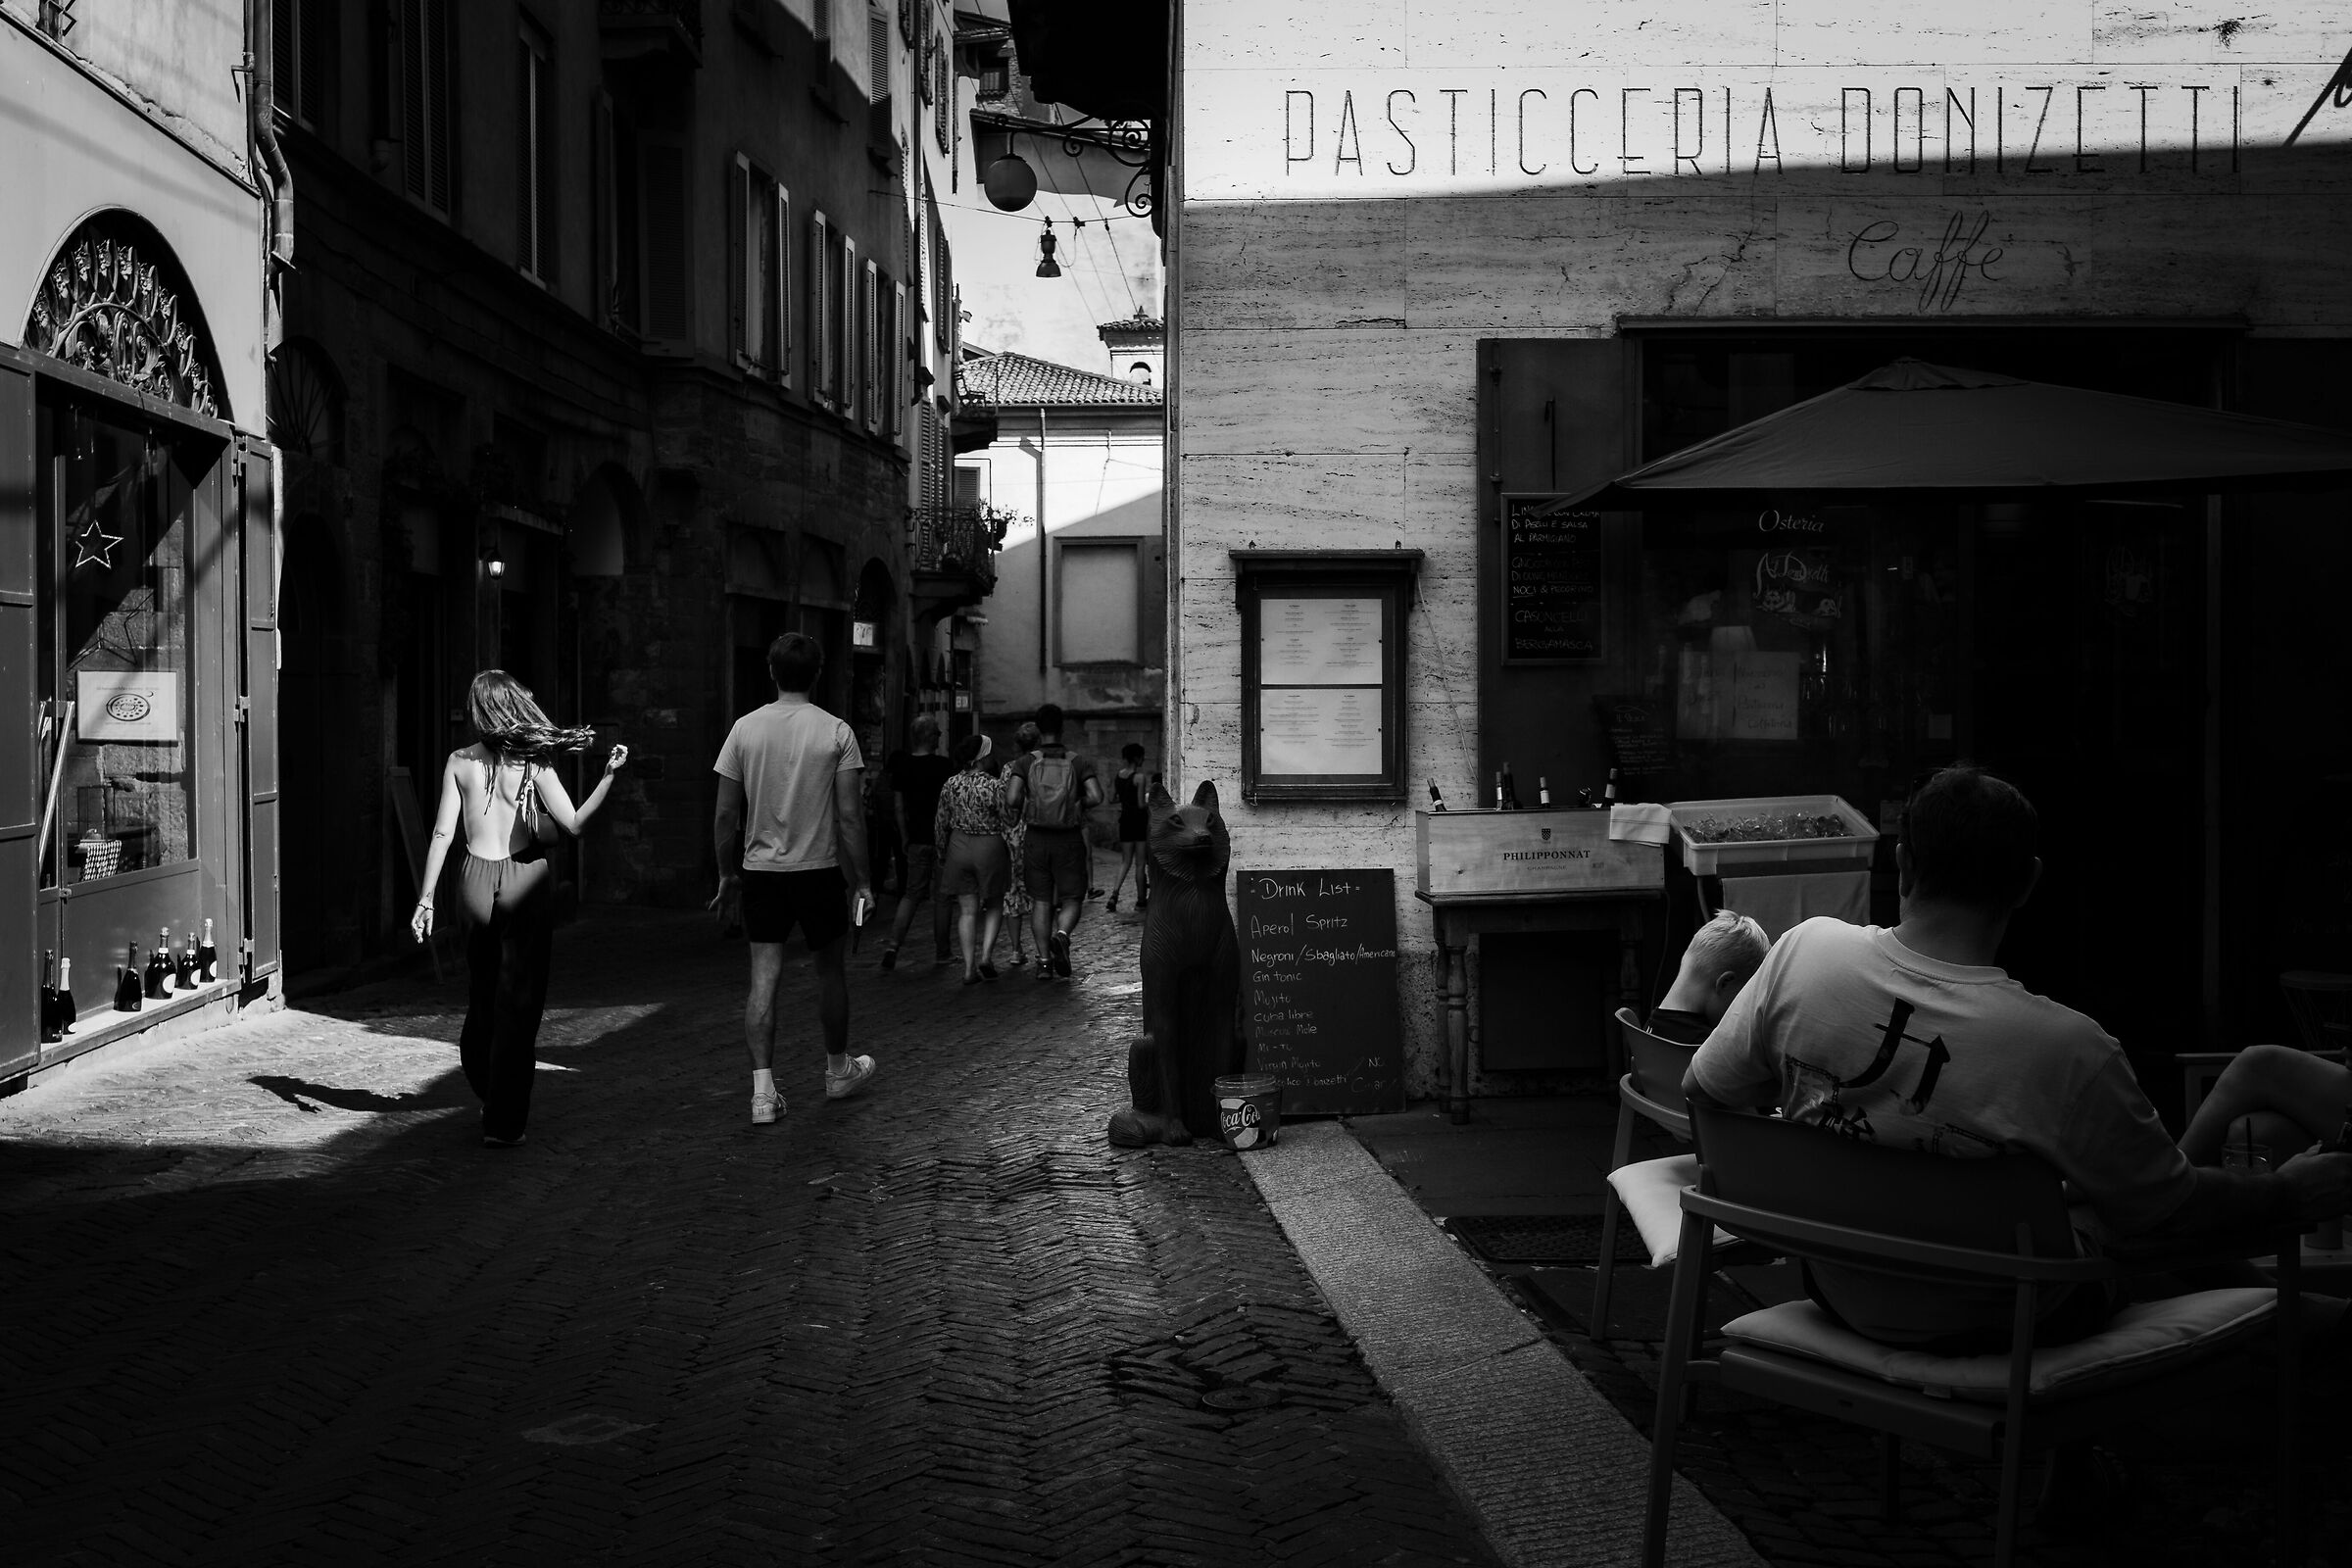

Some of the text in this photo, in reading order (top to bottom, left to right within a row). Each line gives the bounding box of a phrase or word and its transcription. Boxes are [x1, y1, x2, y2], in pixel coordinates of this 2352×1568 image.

[1285, 86, 1783, 177] PASTICCERIA
[1840, 85, 2240, 173] DONIZETTI
[1758, 509, 1826, 533] Osteria
[1513, 532, 1525, 543] AL
[1502, 850, 1592, 861] PHILIPPONNAT
[1250, 912, 1349, 939] Aperol Spritz
